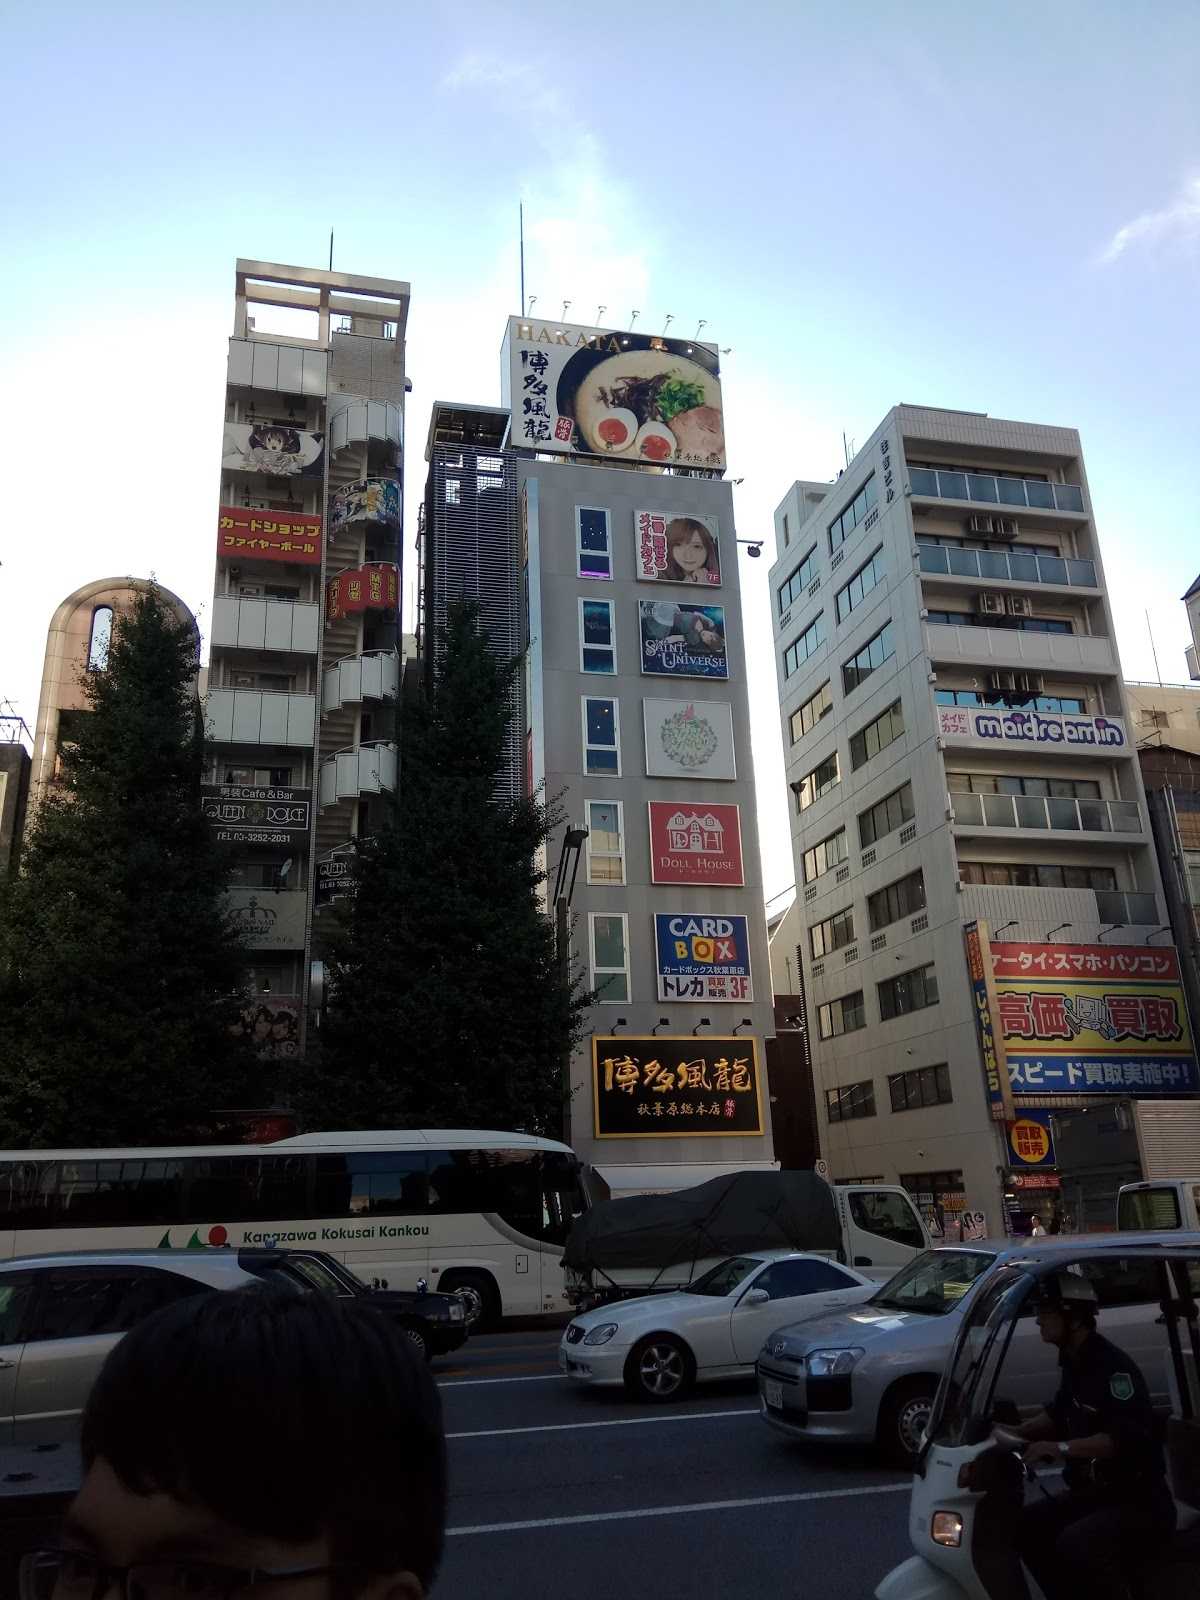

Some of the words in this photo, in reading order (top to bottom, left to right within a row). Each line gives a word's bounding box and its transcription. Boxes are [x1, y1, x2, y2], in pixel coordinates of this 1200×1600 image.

[516, 322, 621, 353] HAKATA
[518, 349, 552, 441] 博多風龍
[220, 516, 321, 537] カードショップ
[224, 535, 315, 553] ファイヤーボール
[640, 512, 655, 576] メイドカフェ
[941, 712, 967, 723] メイド
[942, 724, 968, 734] カフェ
[976, 713, 1124, 746] maidreamin
[669, 918, 734, 937] CARD
[674, 939, 734, 960] BOX
[663, 966, 745, 975] カードボックス秋葉原店
[663, 976, 704, 997] トレカ
[730, 976, 748, 999] 3F
[997, 992, 1073, 1039] 高価
[1104, 995, 1182, 1041] 買取
[600, 1055, 752, 1095] 博多風龍
[637, 1102, 720, 1116] 秋葉原総本店
[1015, 1126, 1042, 1140] 買取
[1017, 1141, 1044, 1156] 販売
[243, 1230, 317, 1244] Kanazawa
[322, 1227, 375, 1241] Kokusai
[379, 1225, 430, 1239] Kankou
